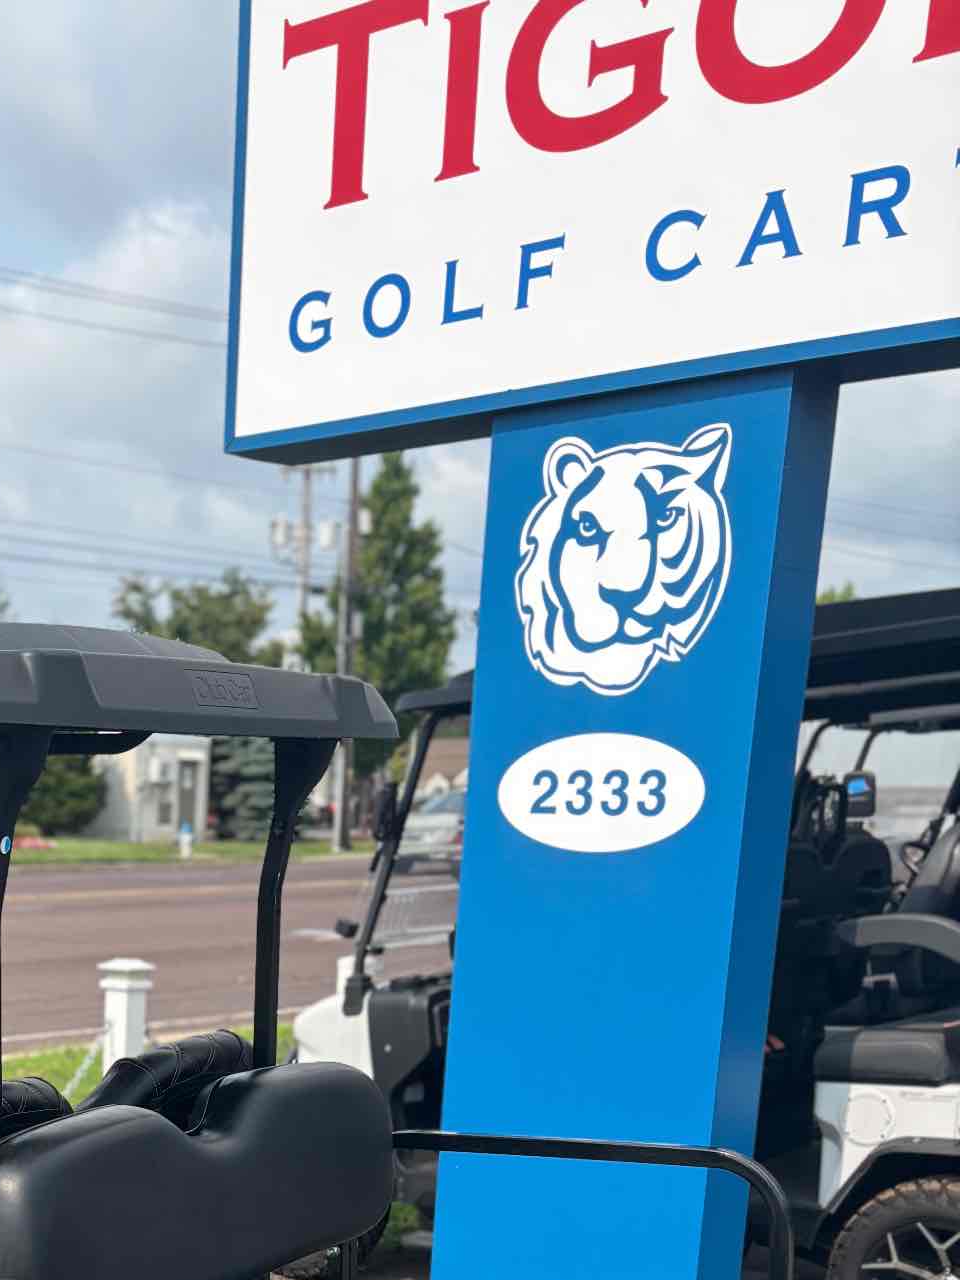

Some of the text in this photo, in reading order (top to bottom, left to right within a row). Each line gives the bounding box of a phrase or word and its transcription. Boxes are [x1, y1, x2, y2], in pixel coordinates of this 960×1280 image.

[283, 0, 960, 211] TIGO
[287, 148, 960, 354] GOLF CAR
[529, 768, 667, 817] 2333
